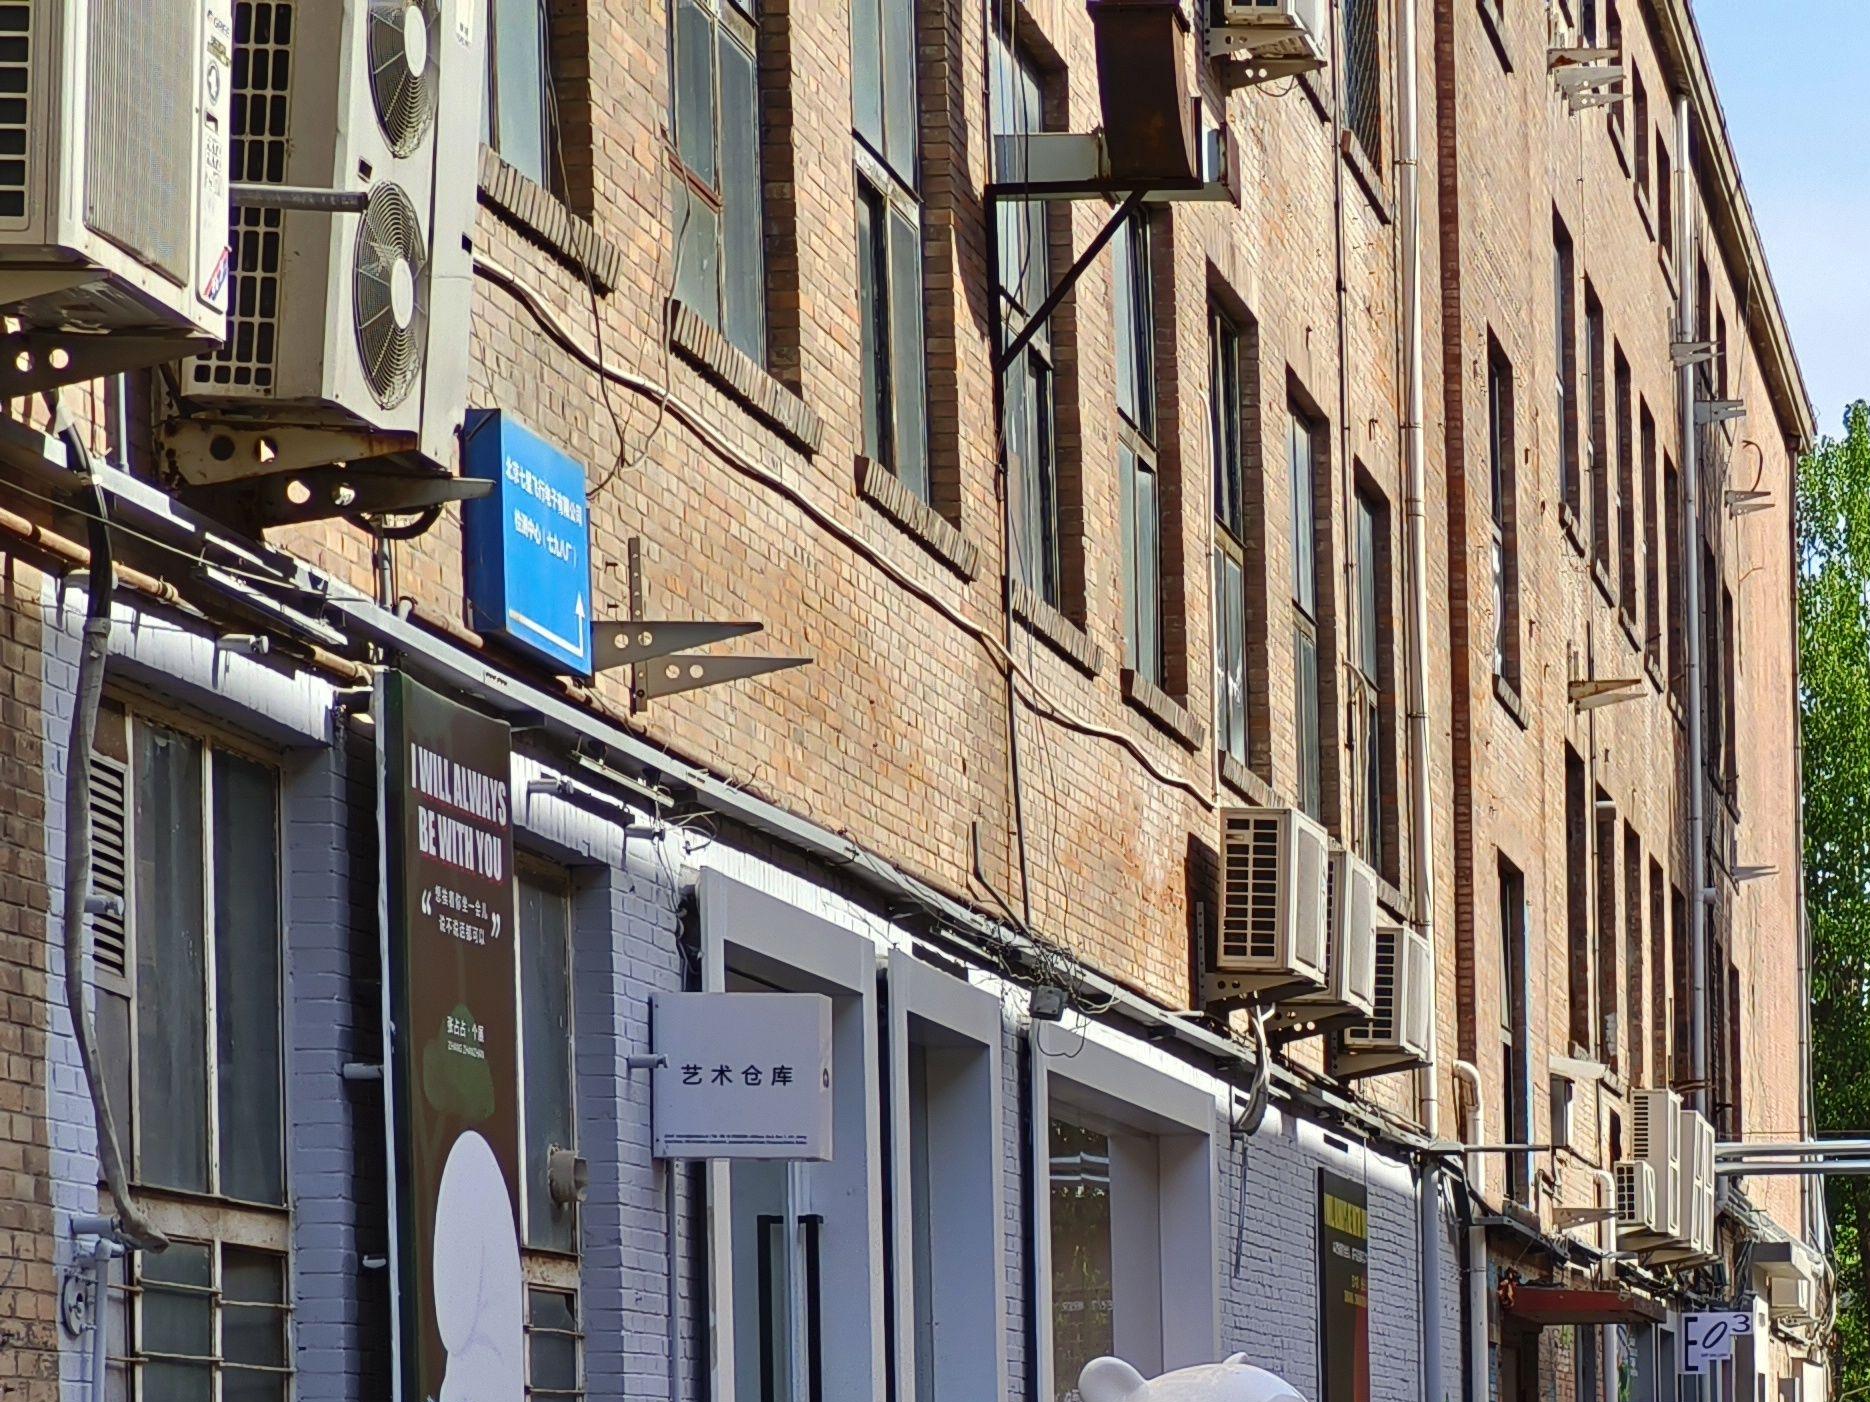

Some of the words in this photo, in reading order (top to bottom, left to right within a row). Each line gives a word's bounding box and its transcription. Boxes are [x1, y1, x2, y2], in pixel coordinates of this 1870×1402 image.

[411, 743, 417, 788] I
[418, 746, 452, 804] WILL
[453, 763, 507, 826] ALWAYS
[418, 806, 436, 856] BE
[438, 813, 474, 871] WITH
[475, 829, 502, 881] YOU
[681, 1064, 793, 1086] 艺术仓库
